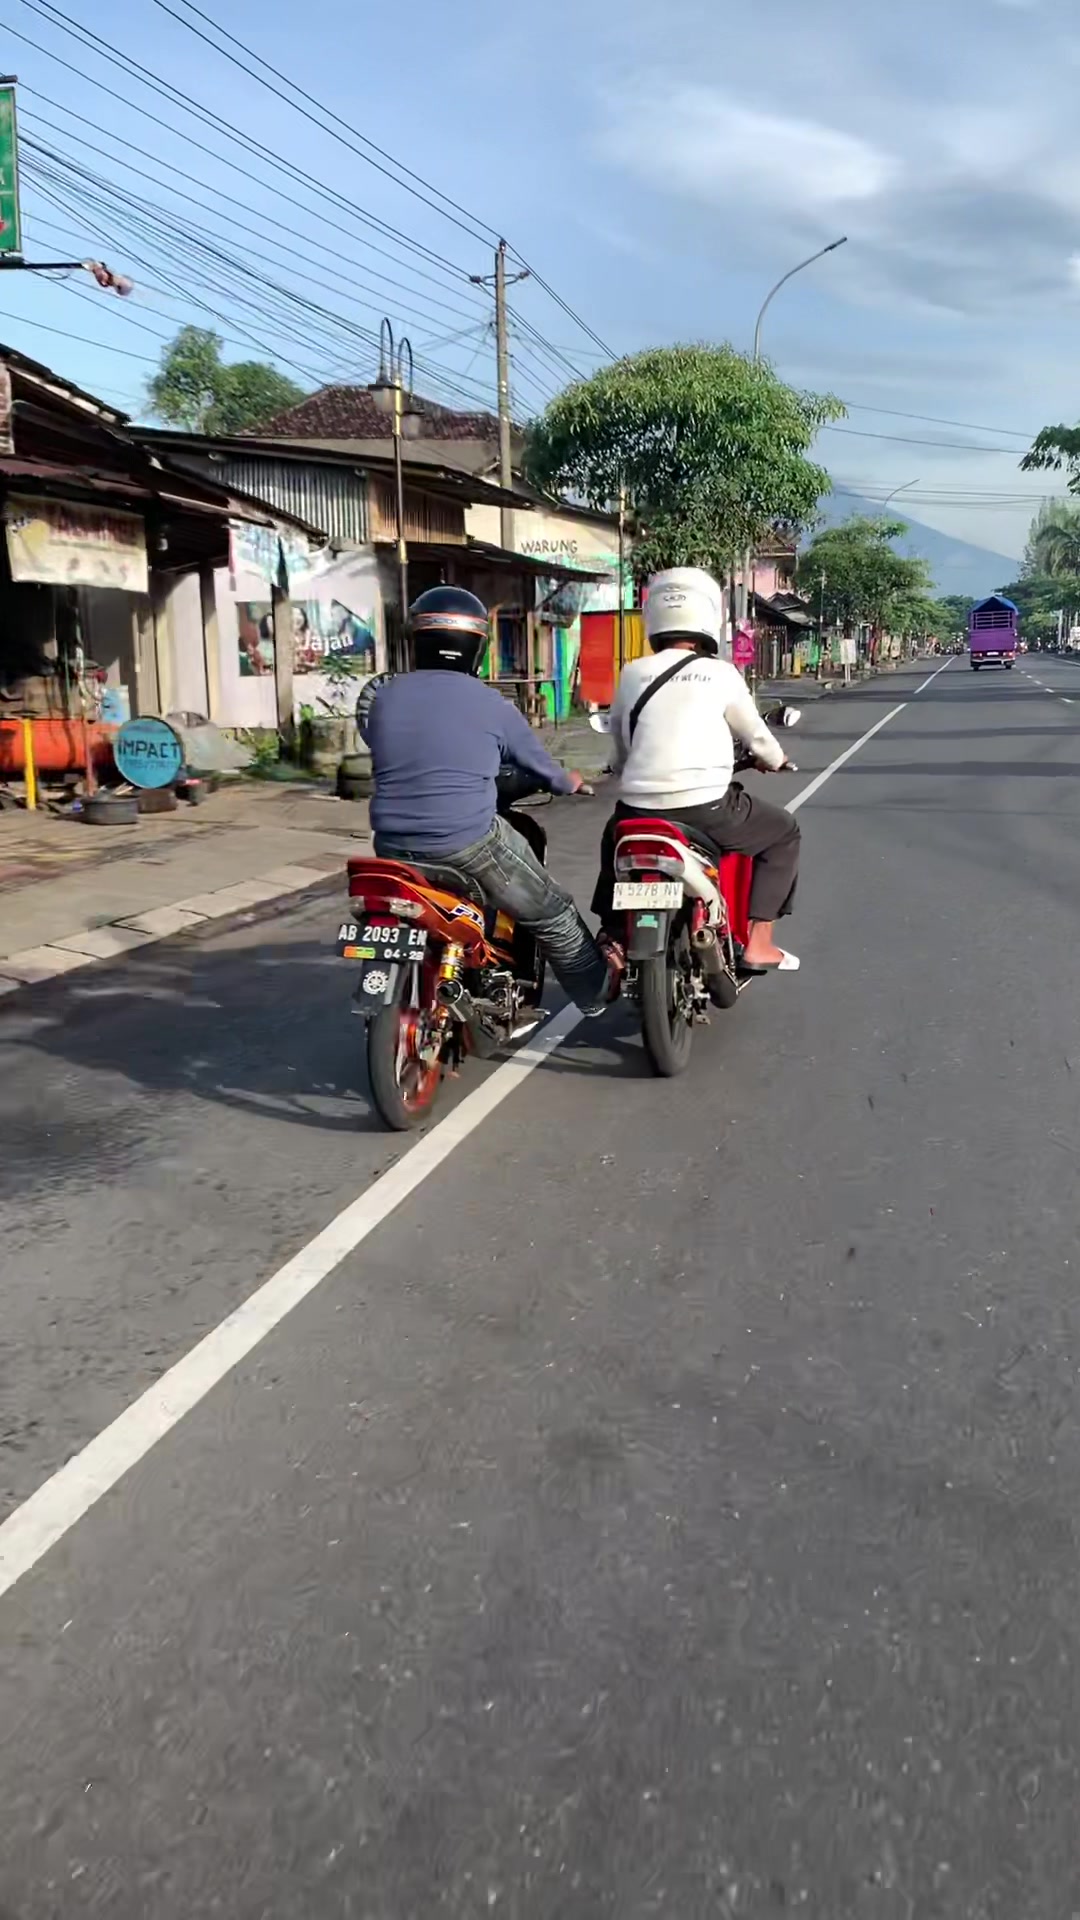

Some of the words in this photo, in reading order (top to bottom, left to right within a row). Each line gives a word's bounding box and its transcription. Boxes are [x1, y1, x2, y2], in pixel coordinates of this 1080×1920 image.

[520, 539, 578, 554] WARUNG
[118, 738, 180, 758] IMPACT
[338, 924, 358, 941] AB
[362, 926, 400, 943] 2093
